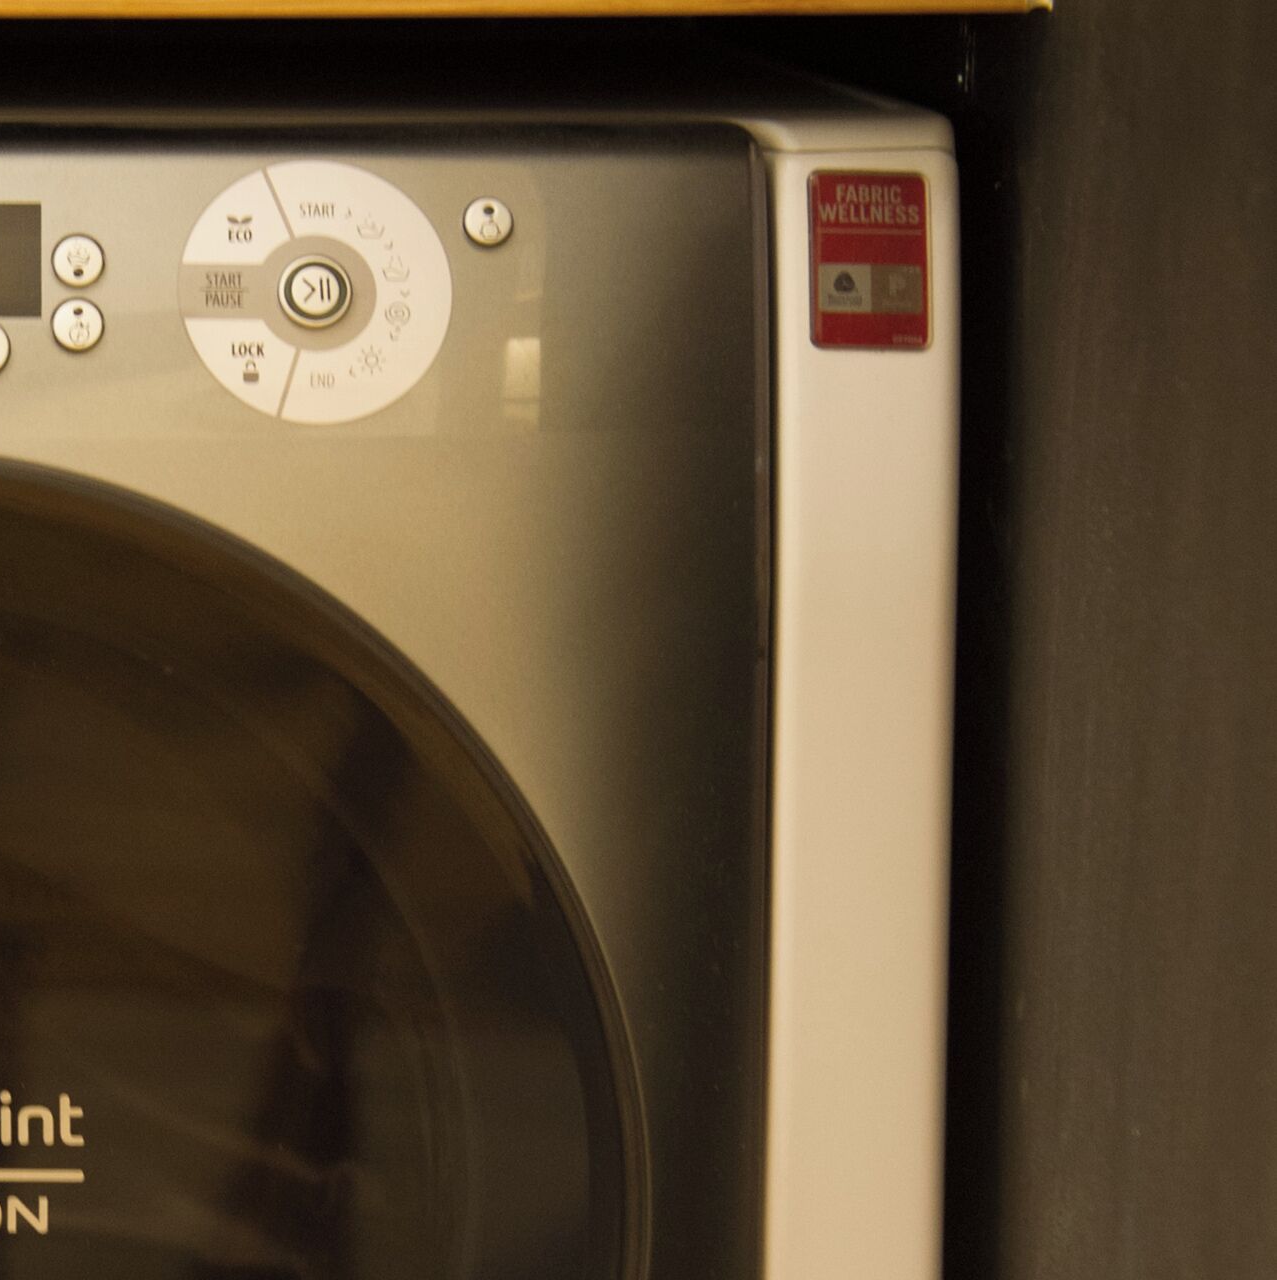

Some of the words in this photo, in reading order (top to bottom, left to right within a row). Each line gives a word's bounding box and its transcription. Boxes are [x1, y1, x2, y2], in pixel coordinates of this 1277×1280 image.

[835, 183, 902, 204] FABRIC
[299, 202, 335, 218] START
[819, 204, 920, 225] WELLNESS
[228, 229, 253, 243] ECO
[205, 272, 242, 288] START
[205, 290, 244, 309] PAUSE
[231, 343, 265, 358] LOCK
[309, 372, 336, 388] END
